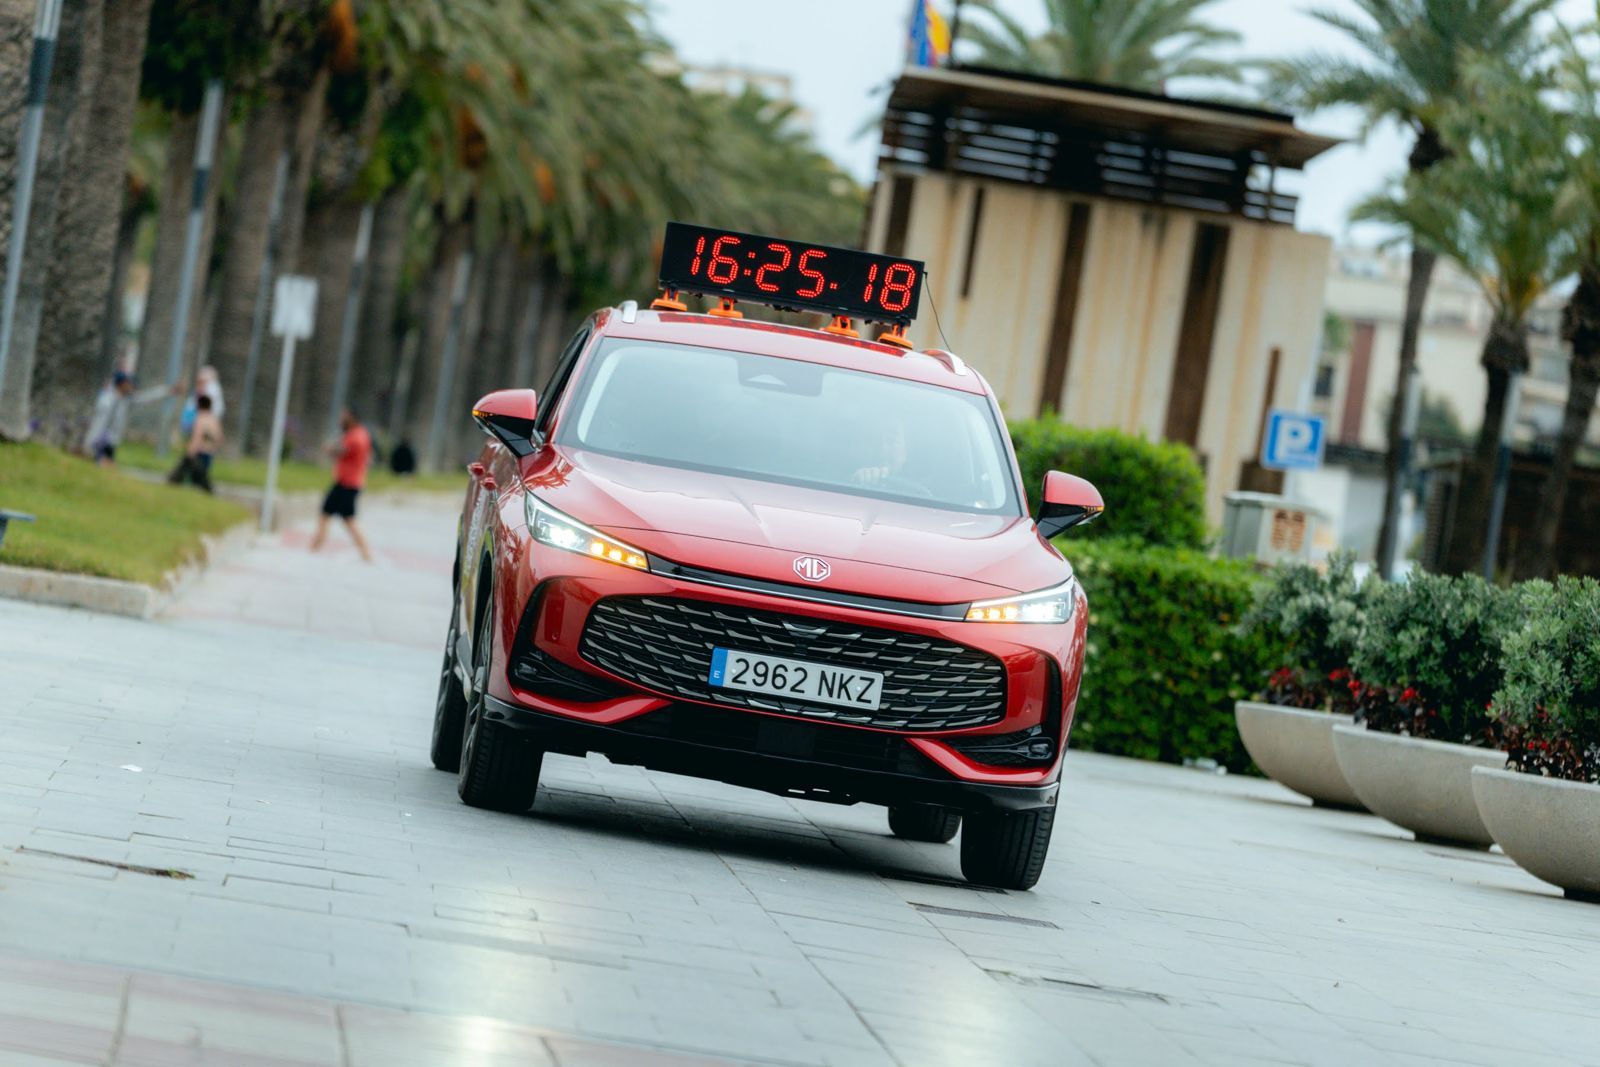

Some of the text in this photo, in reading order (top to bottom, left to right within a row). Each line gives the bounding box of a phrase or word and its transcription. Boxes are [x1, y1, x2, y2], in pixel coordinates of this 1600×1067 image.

[1274, 416, 1312, 459] P
[795, 557, 829, 580] MG
[713, 657, 876, 705] E 2962 NKZ
